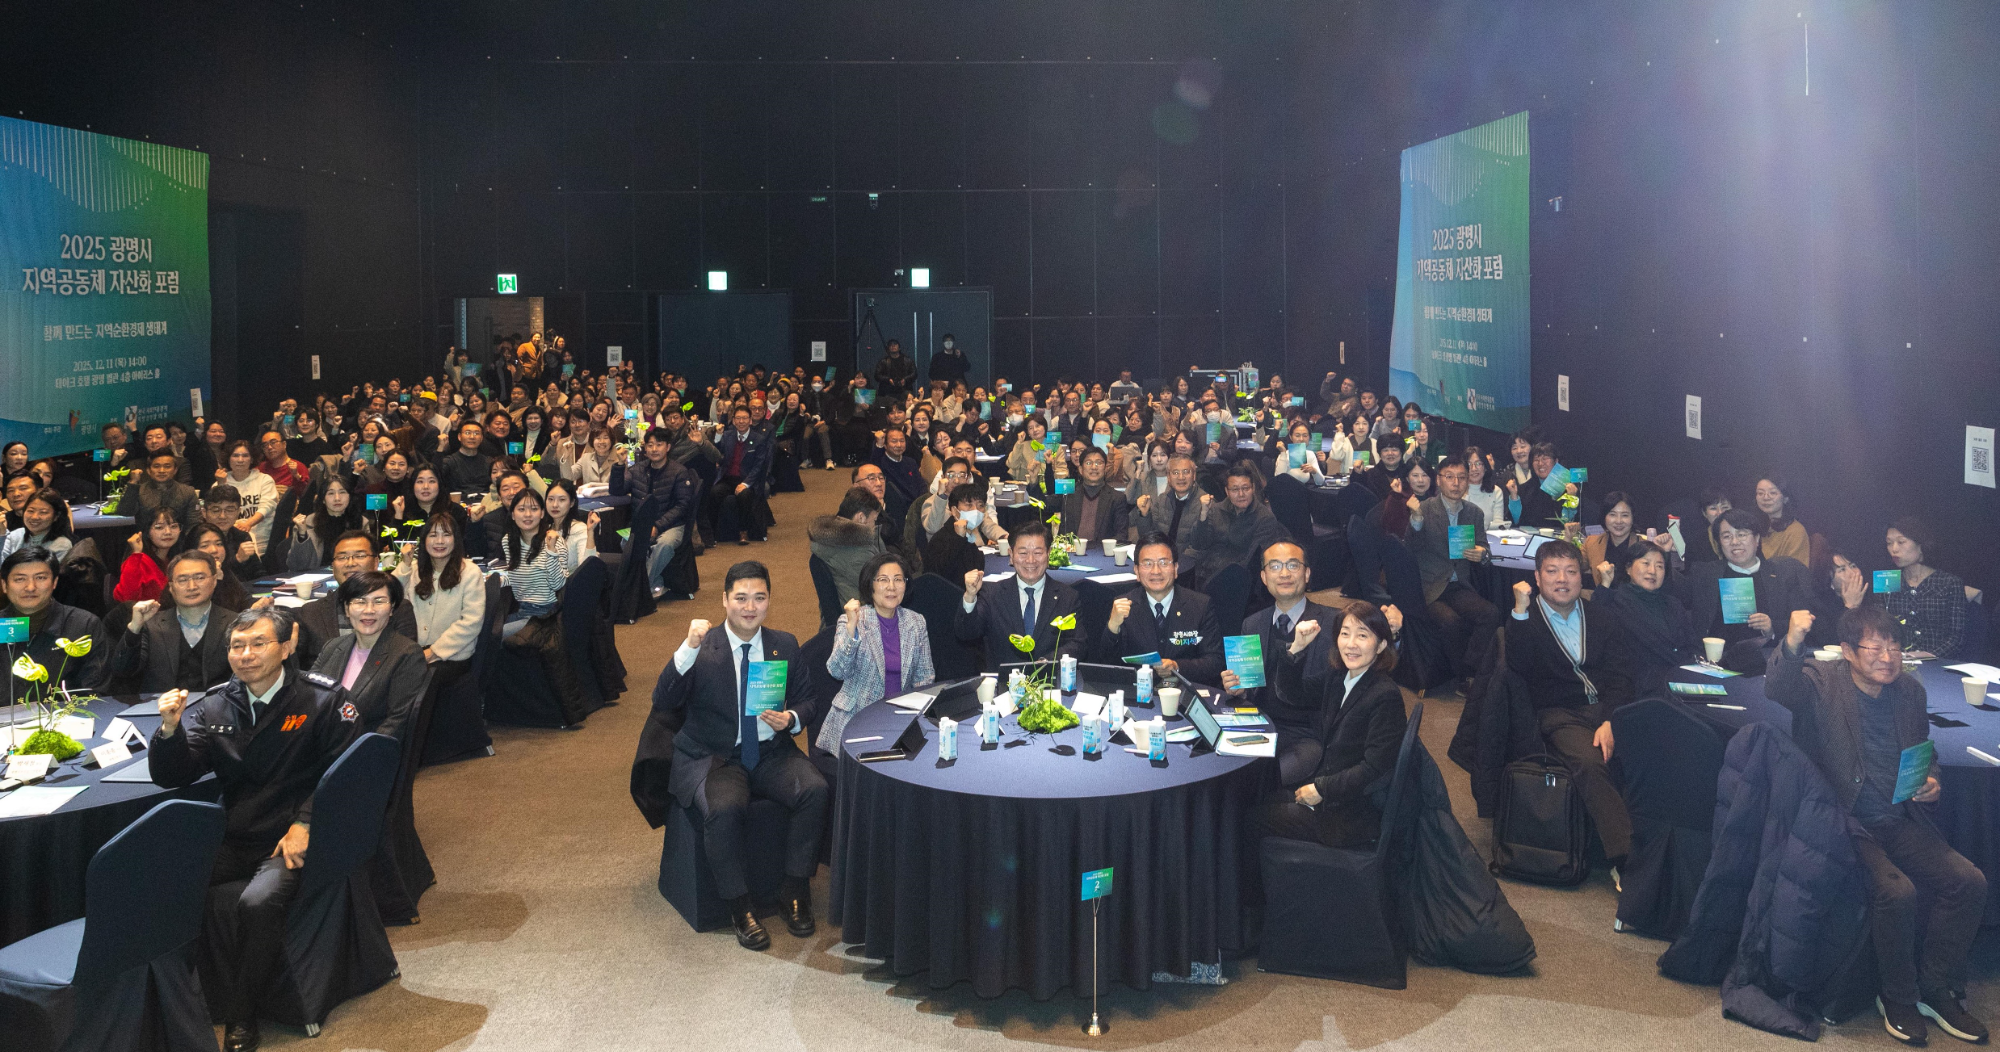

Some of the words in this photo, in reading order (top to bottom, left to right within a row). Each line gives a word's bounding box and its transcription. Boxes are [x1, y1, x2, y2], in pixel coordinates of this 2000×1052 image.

[60, 233, 106, 260] 2025
[110, 236, 152, 263] 광명시
[1432, 228, 1454, 251] 2025
[1456, 223, 1482, 251] 광명시
[1455, 255, 1482, 281] 자산화
[1484, 254, 1503, 280] 포럼
[22, 267, 106, 295] 지역공동체
[109, 269, 152, 294] 자산화
[155, 271, 180, 294] 포럼
[43, 325, 63, 341] 함께
[65, 324, 93, 340] 만드는
[95, 321, 145, 338] 지역순환경제
[146, 320, 168, 336] 생태계
[128, 356, 147, 367] 14:00
[8, 626, 14, 635] 3
[1095, 880, 1100, 889] 2
